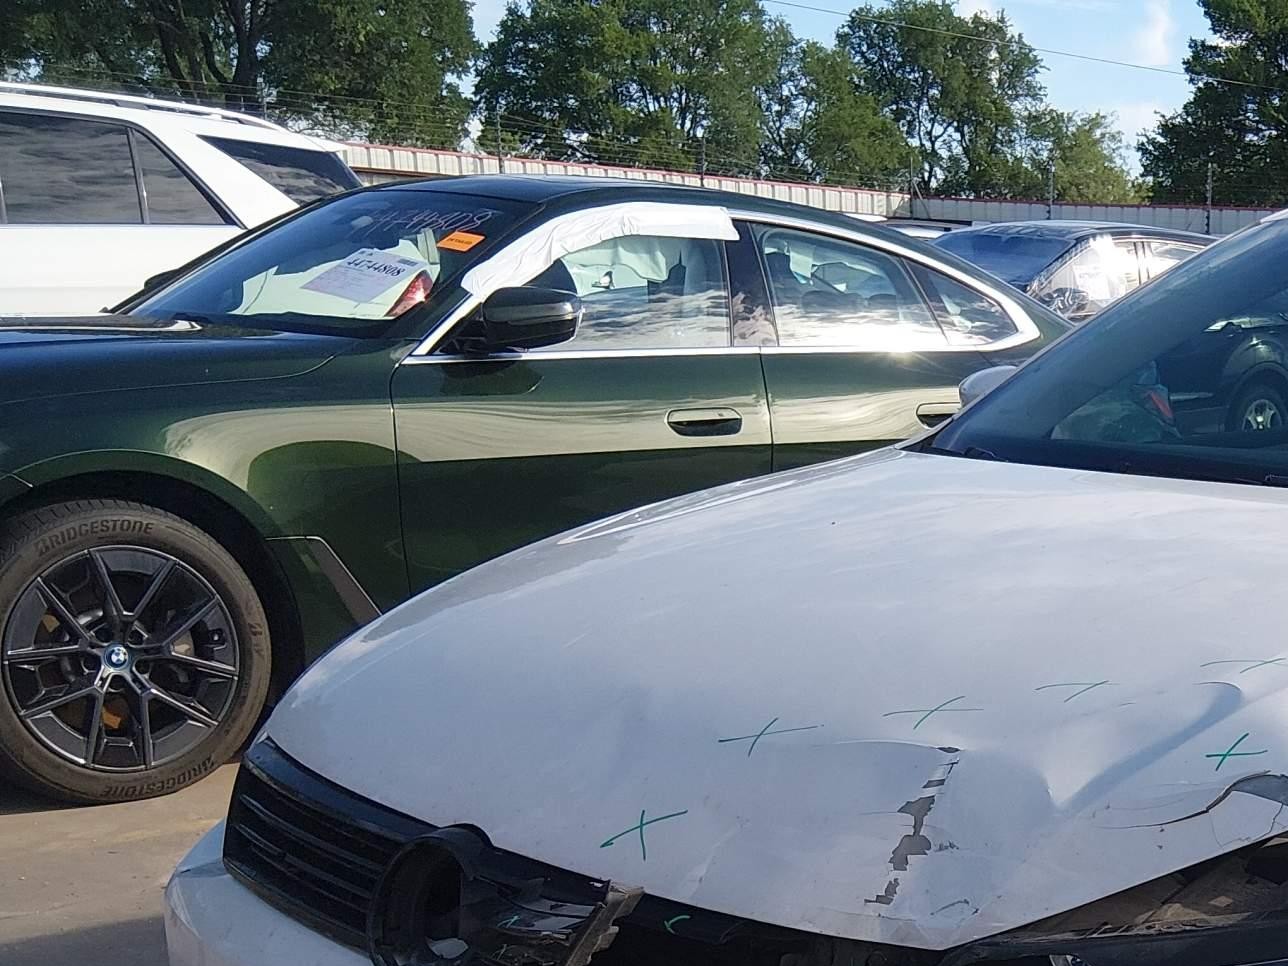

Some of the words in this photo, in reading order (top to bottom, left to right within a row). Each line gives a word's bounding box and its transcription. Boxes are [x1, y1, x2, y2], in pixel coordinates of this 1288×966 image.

[347, 256, 406, 277] 44744808
[33, 518, 154, 553] BRIDGESTONE
[103, 757, 216, 799] BRIDGESTONE
